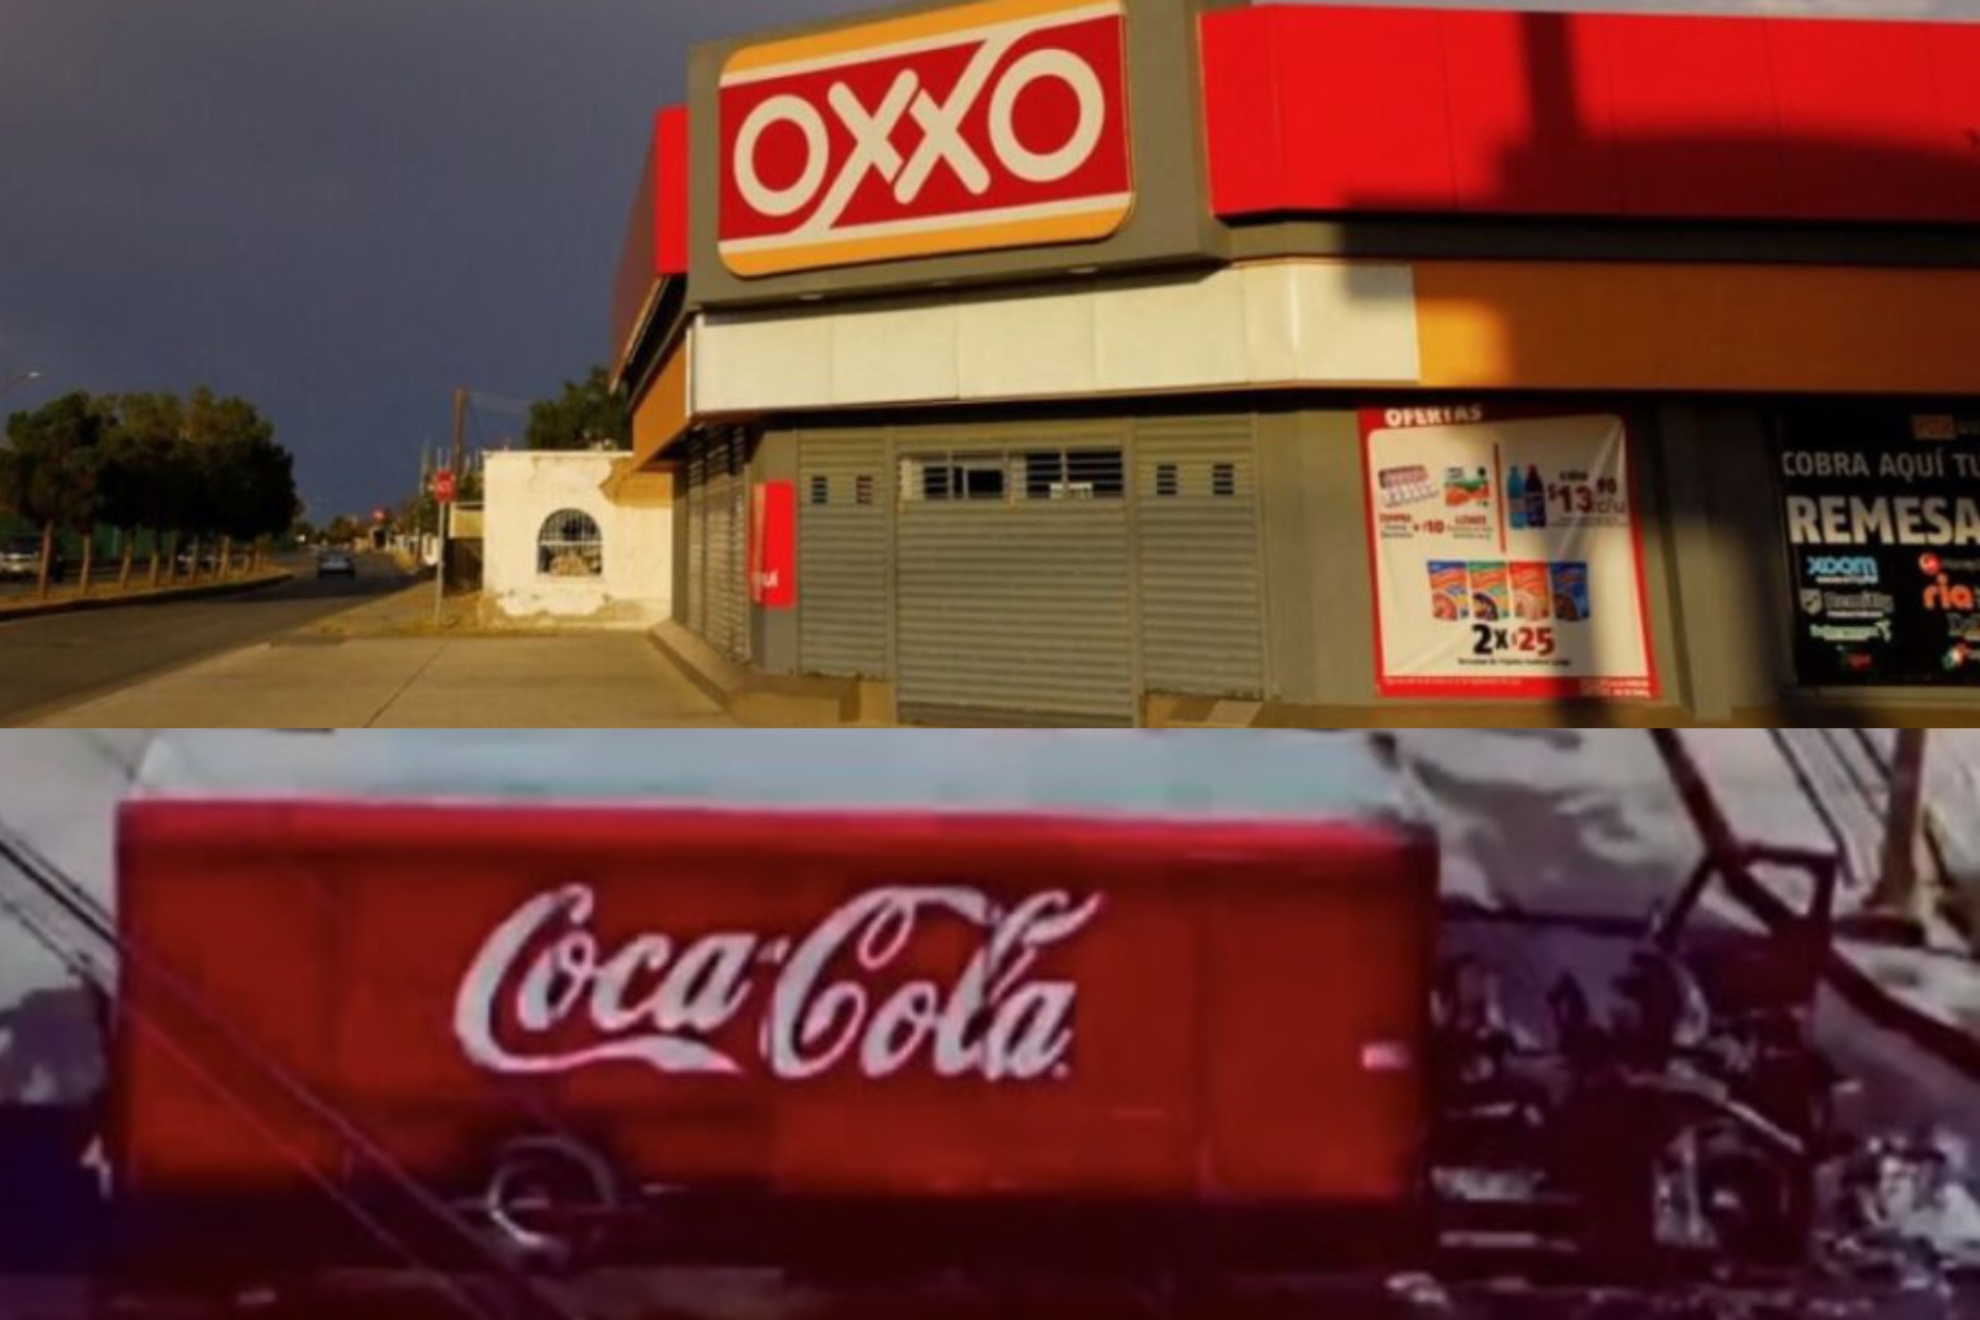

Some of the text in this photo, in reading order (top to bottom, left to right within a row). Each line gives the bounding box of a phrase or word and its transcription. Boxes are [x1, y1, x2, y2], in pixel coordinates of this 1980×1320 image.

[733, 36, 1105, 236] OXXO
[1782, 451, 1870, 478] COBRA
[1879, 448, 1944, 483] AQUÍ
[1807, 556, 1878, 576] xoom
[1922, 574, 1973, 610] ria
[454, 883, 1102, 1080] Coca-Cola
